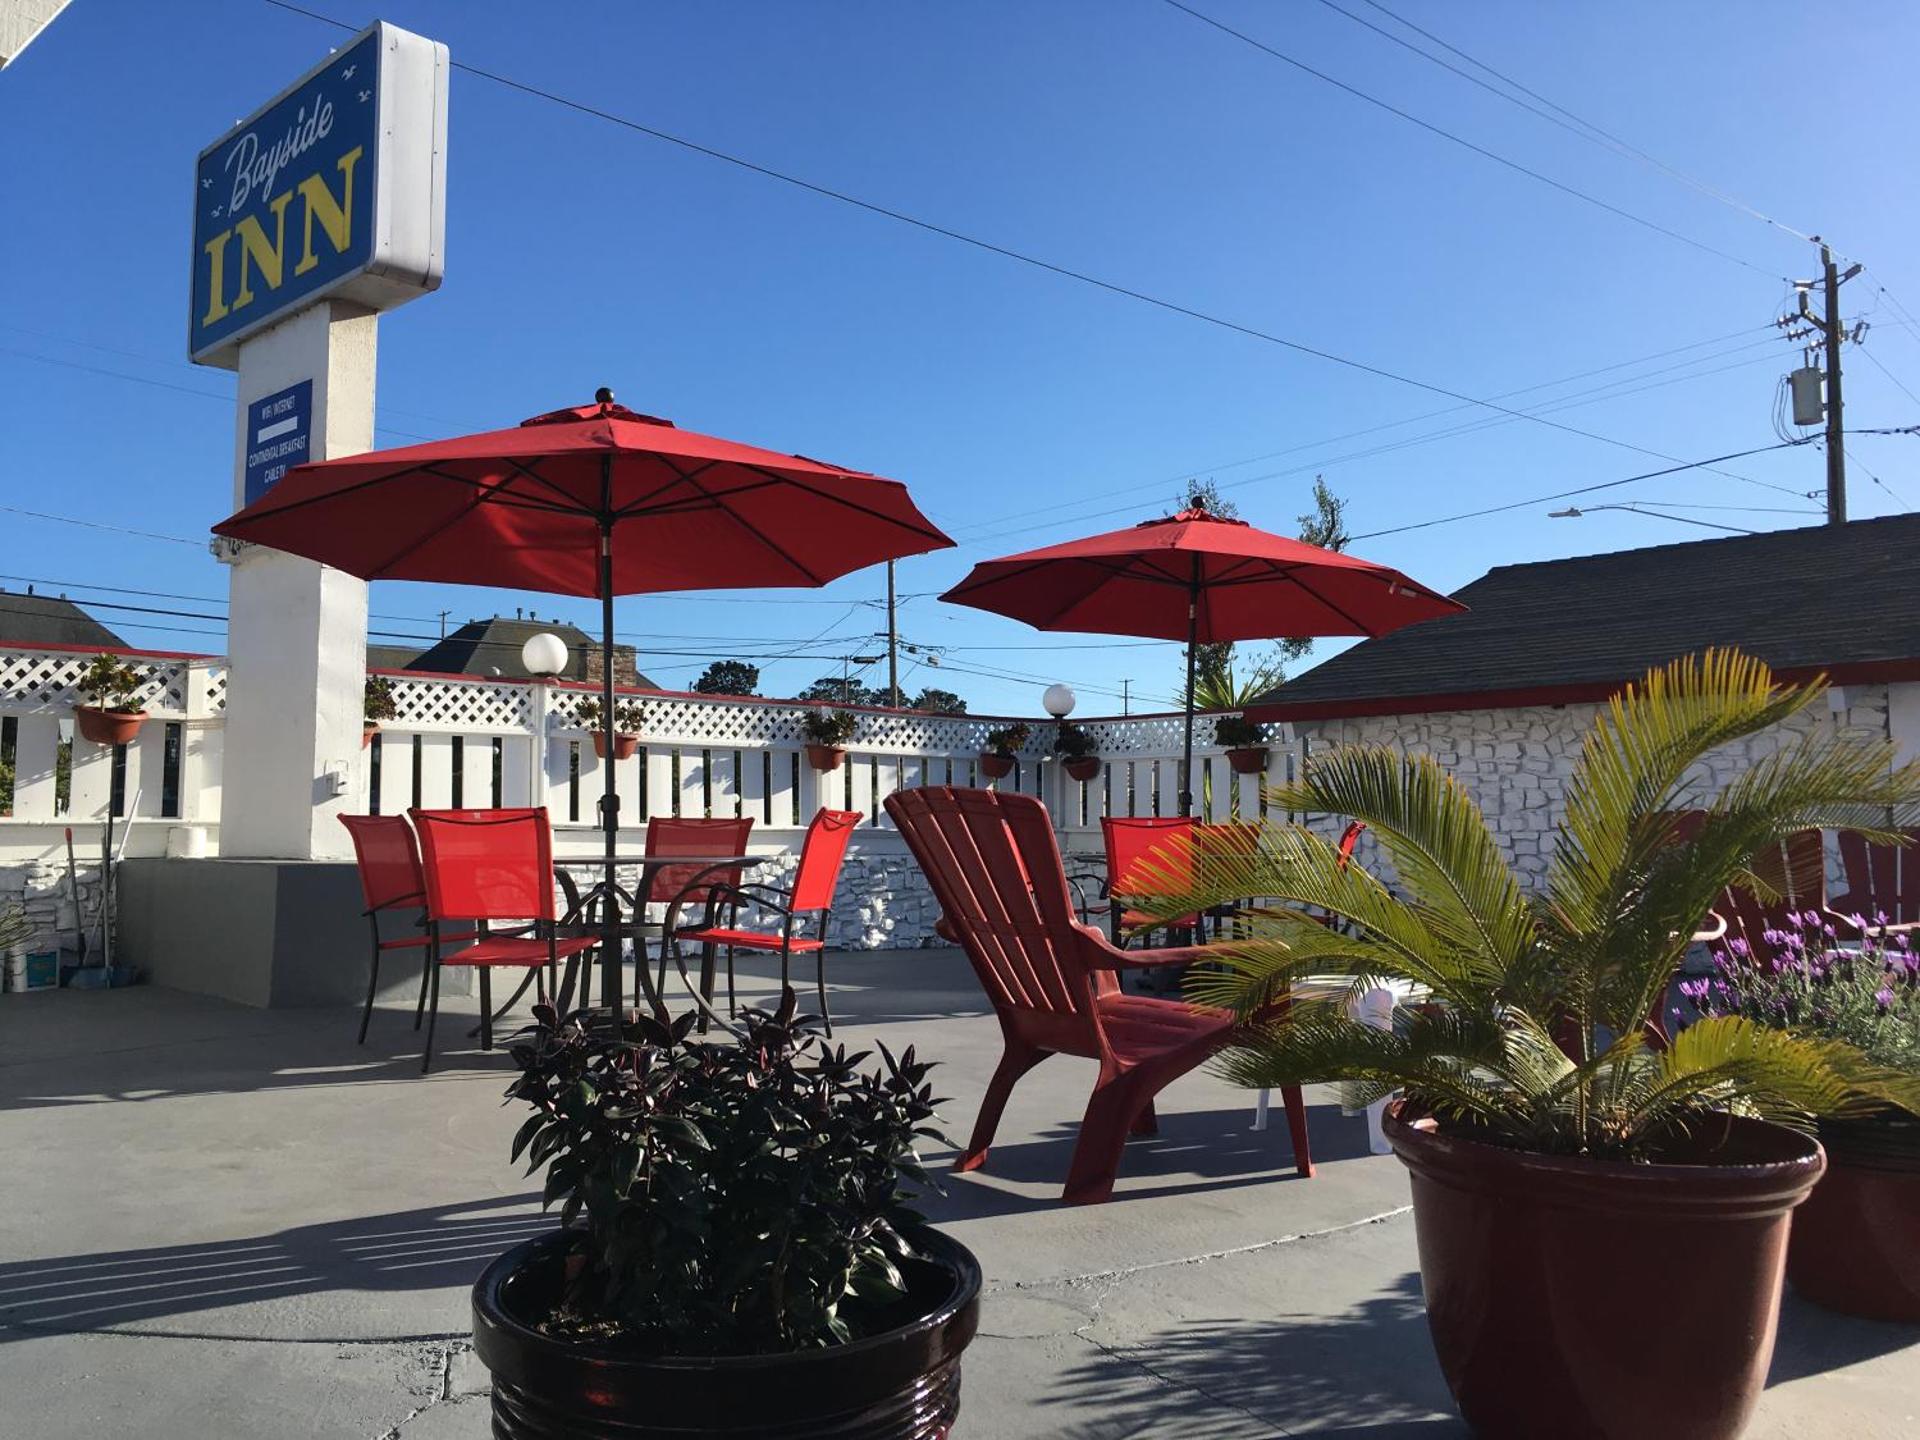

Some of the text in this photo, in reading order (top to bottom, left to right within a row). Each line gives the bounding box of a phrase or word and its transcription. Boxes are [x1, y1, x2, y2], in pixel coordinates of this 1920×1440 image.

[225, 94, 333, 218] Bayside
[203, 144, 363, 328] INN
[264, 466, 279, 483] CABLE
[279, 434, 306, 457] BREAKFAST
